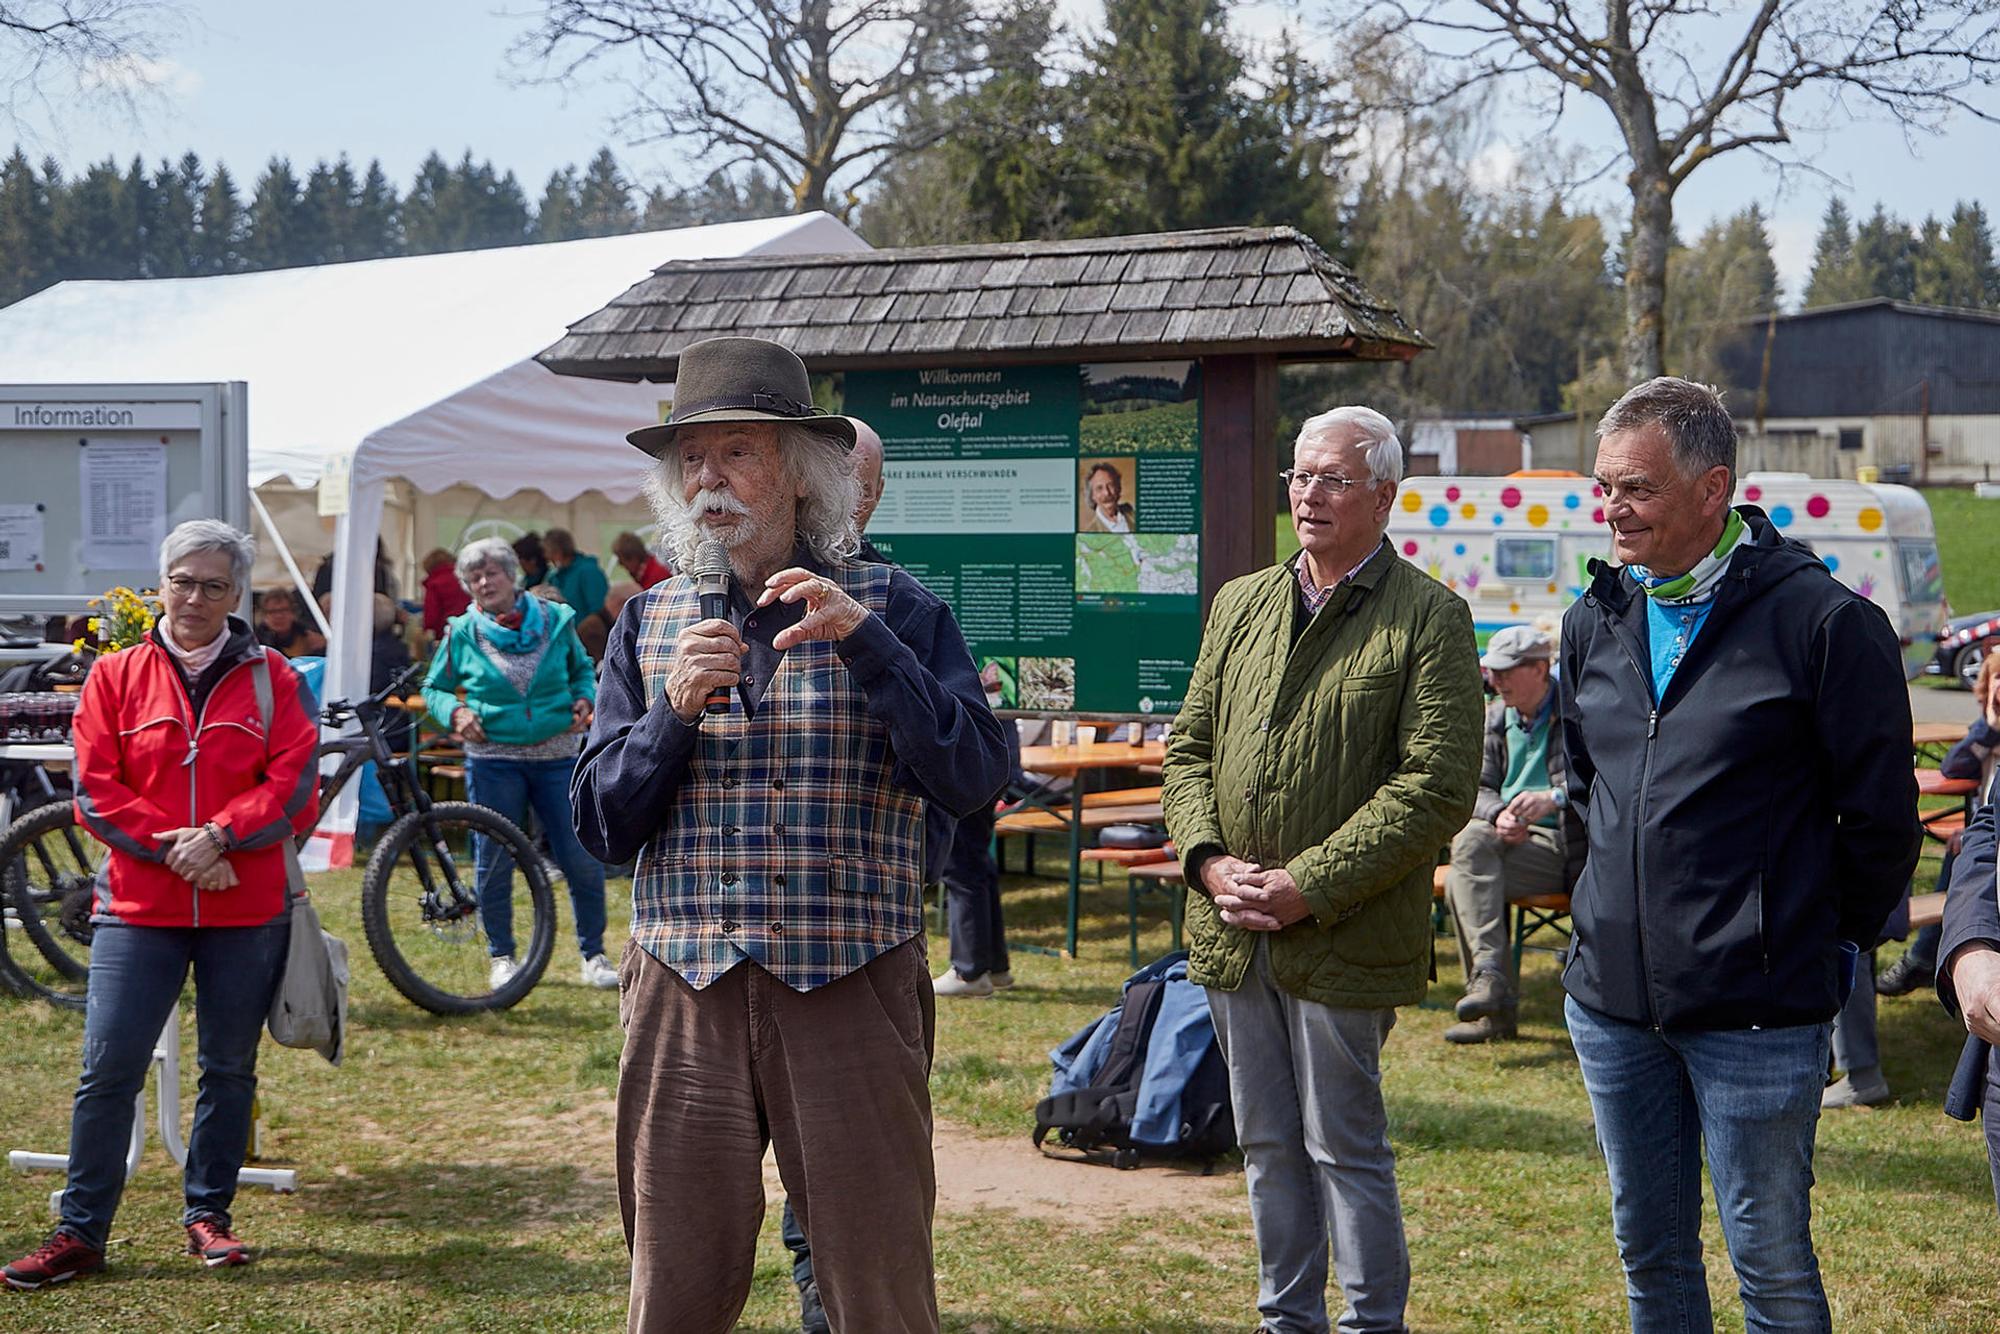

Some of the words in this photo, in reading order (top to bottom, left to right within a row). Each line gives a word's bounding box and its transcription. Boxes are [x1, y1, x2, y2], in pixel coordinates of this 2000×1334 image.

[919, 368, 1001, 384] Willkommen
[891, 393, 908, 408] im
[912, 389, 1030, 409] Naturschutzgebiet
[14, 406, 134, 425] Information
[937, 412, 983, 432] Oleftal
[884, 470, 902, 479] ÄRE
[946, 468, 1018, 479] VERSCHWUNDEN
